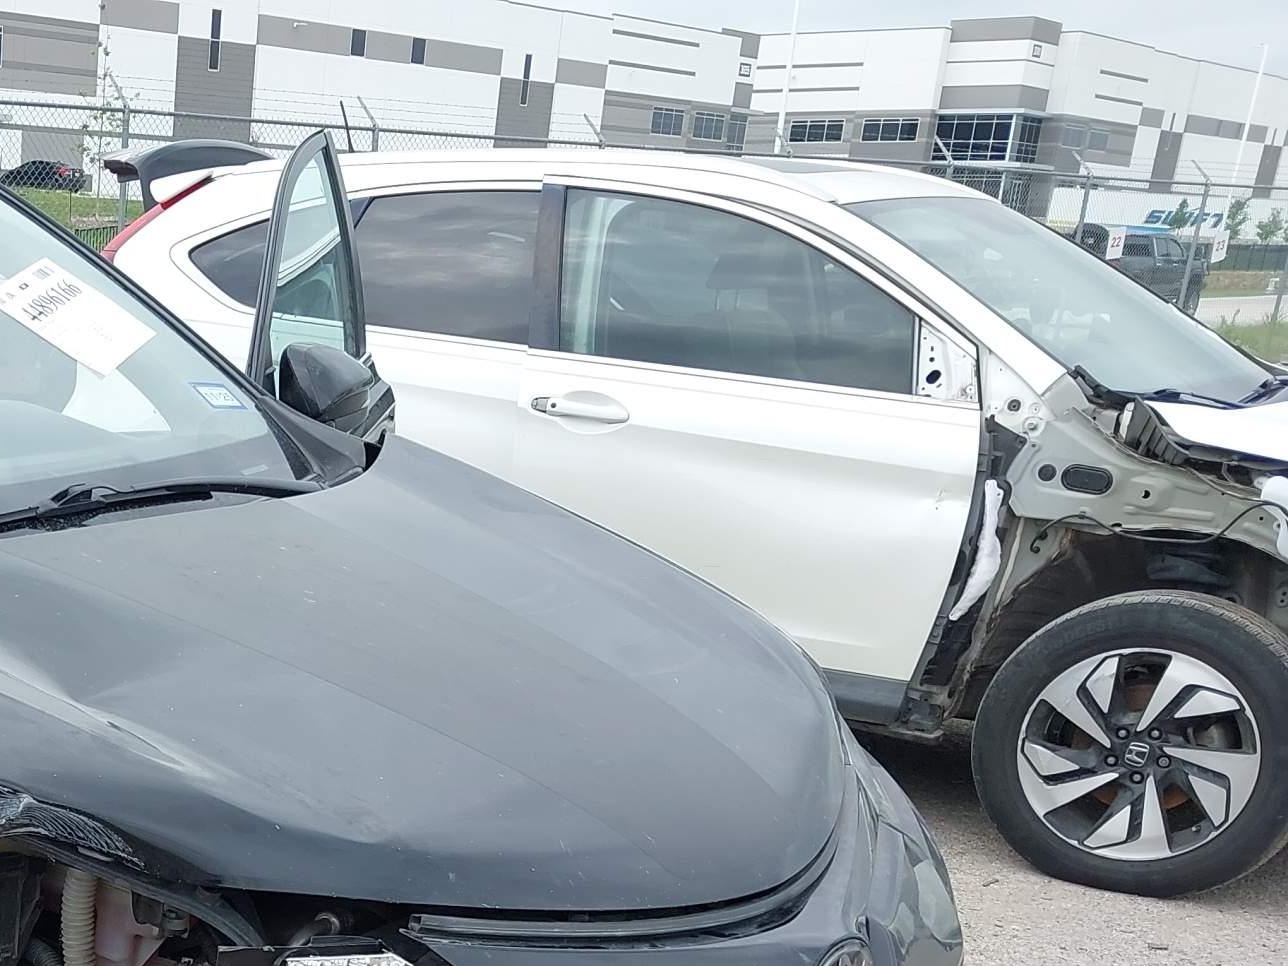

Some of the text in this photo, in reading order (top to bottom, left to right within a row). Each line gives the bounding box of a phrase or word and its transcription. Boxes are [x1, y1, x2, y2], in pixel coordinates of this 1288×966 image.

[1110, 237, 1122, 248] 22
[1215, 240, 1226, 252] 23
[21, 279, 82, 321] 44896166
